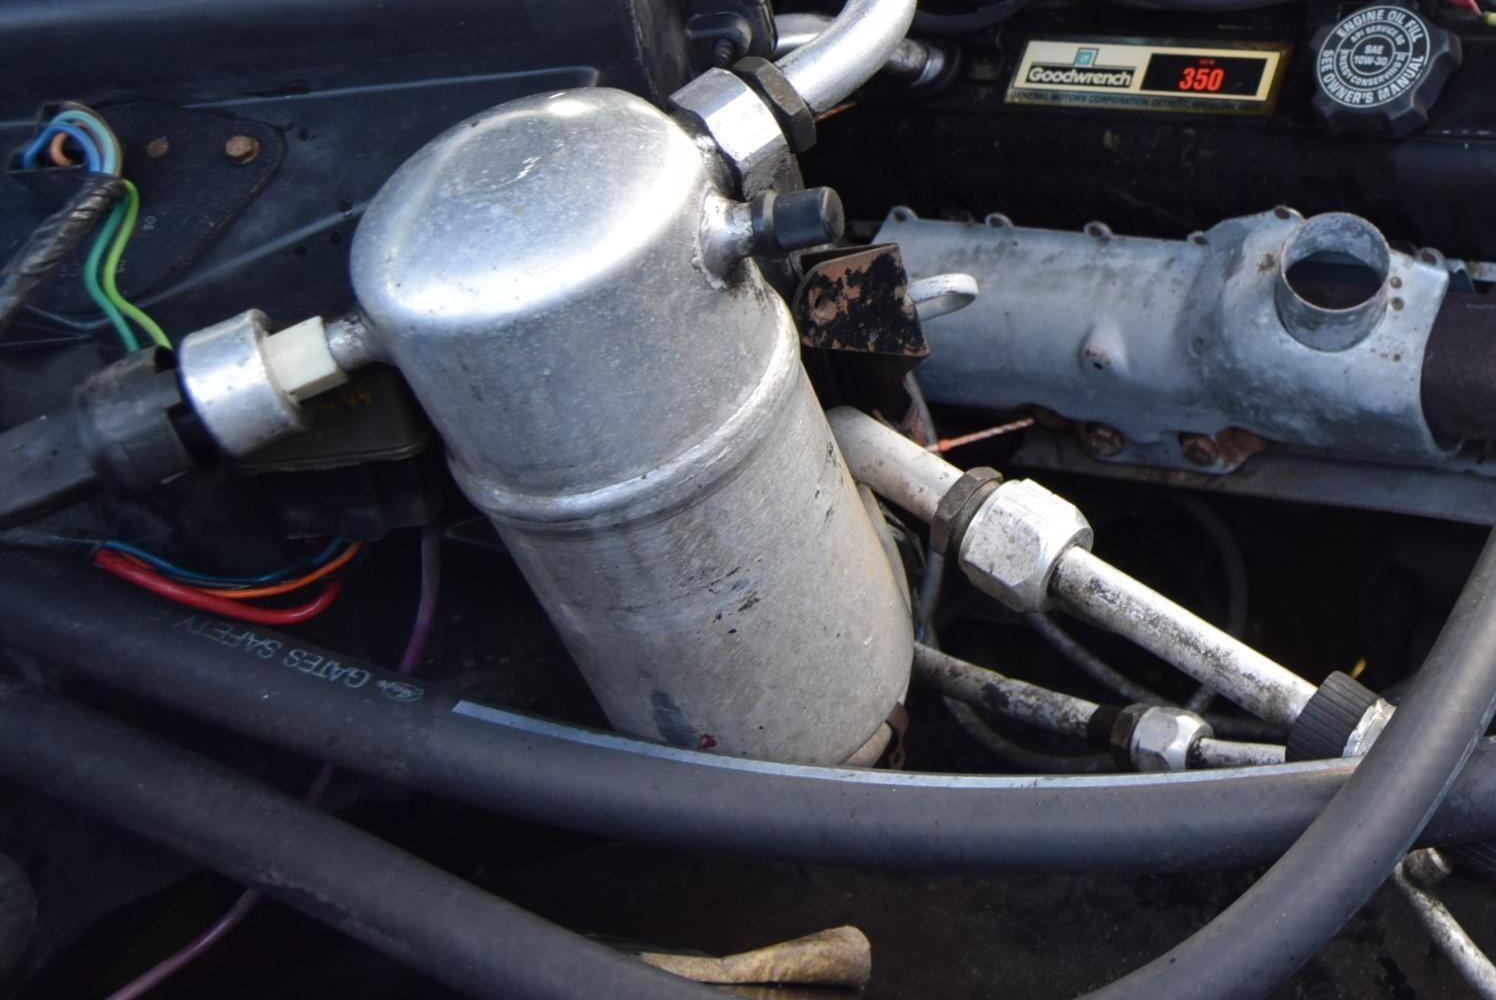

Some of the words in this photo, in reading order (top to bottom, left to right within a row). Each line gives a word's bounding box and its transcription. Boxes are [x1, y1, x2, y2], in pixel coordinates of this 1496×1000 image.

[1336, 9, 1385, 38] ENGINE
[1387, 10, 1407, 25] OIL
[1404, 19, 1424, 43] FILL
[1365, 24, 1399, 37] SERVICE
[1321, 49, 1334, 72] SEE
[1353, 55, 1388, 67] 10W-30
[1364, 44, 1384, 55] SAE
[1028, 67, 1131, 88] Goodwrench
[1179, 67, 1225, 91] 350
[1350, 62, 1402, 87] CONSERVING
[1377, 56, 1424, 100] MANUAL
[1323, 73, 1374, 104] OWNER'S
[172, 615, 283, 660] SAFETY
[282, 648, 372, 689] GATES
